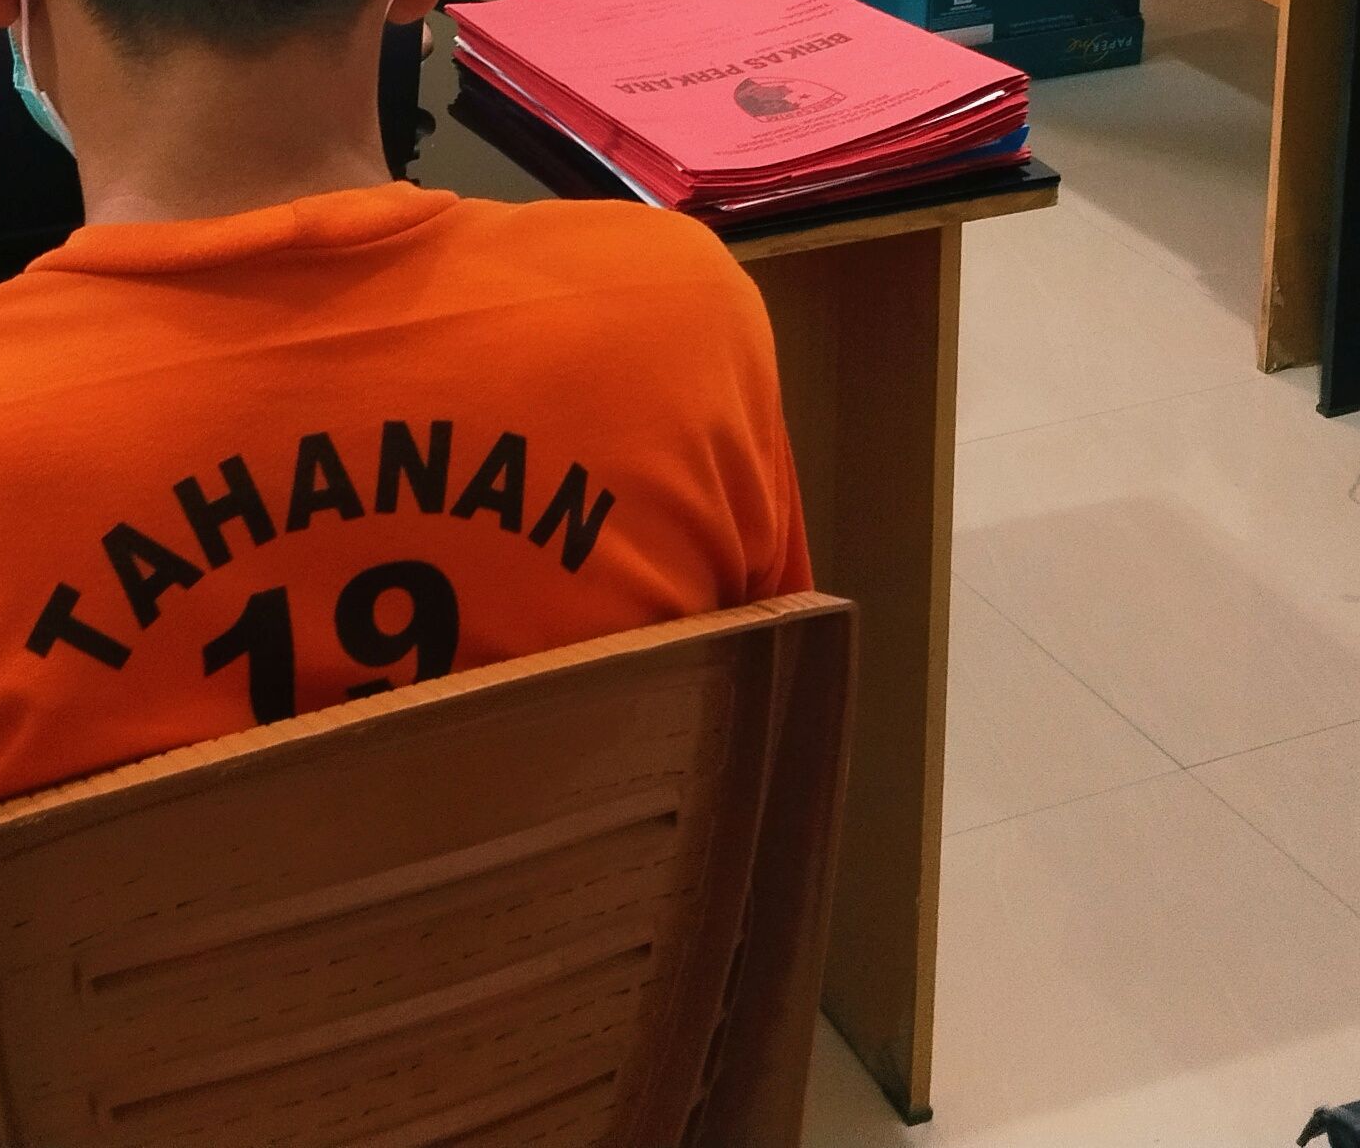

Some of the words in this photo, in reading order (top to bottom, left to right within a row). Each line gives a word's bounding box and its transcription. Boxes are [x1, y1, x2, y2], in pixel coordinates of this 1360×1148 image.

[611, 63, 744, 95] PERKARA
[743, 32, 852, 70] BERKAS
[25, 420, 615, 670] TAHANAN
[203, 560, 460, 725] 19
